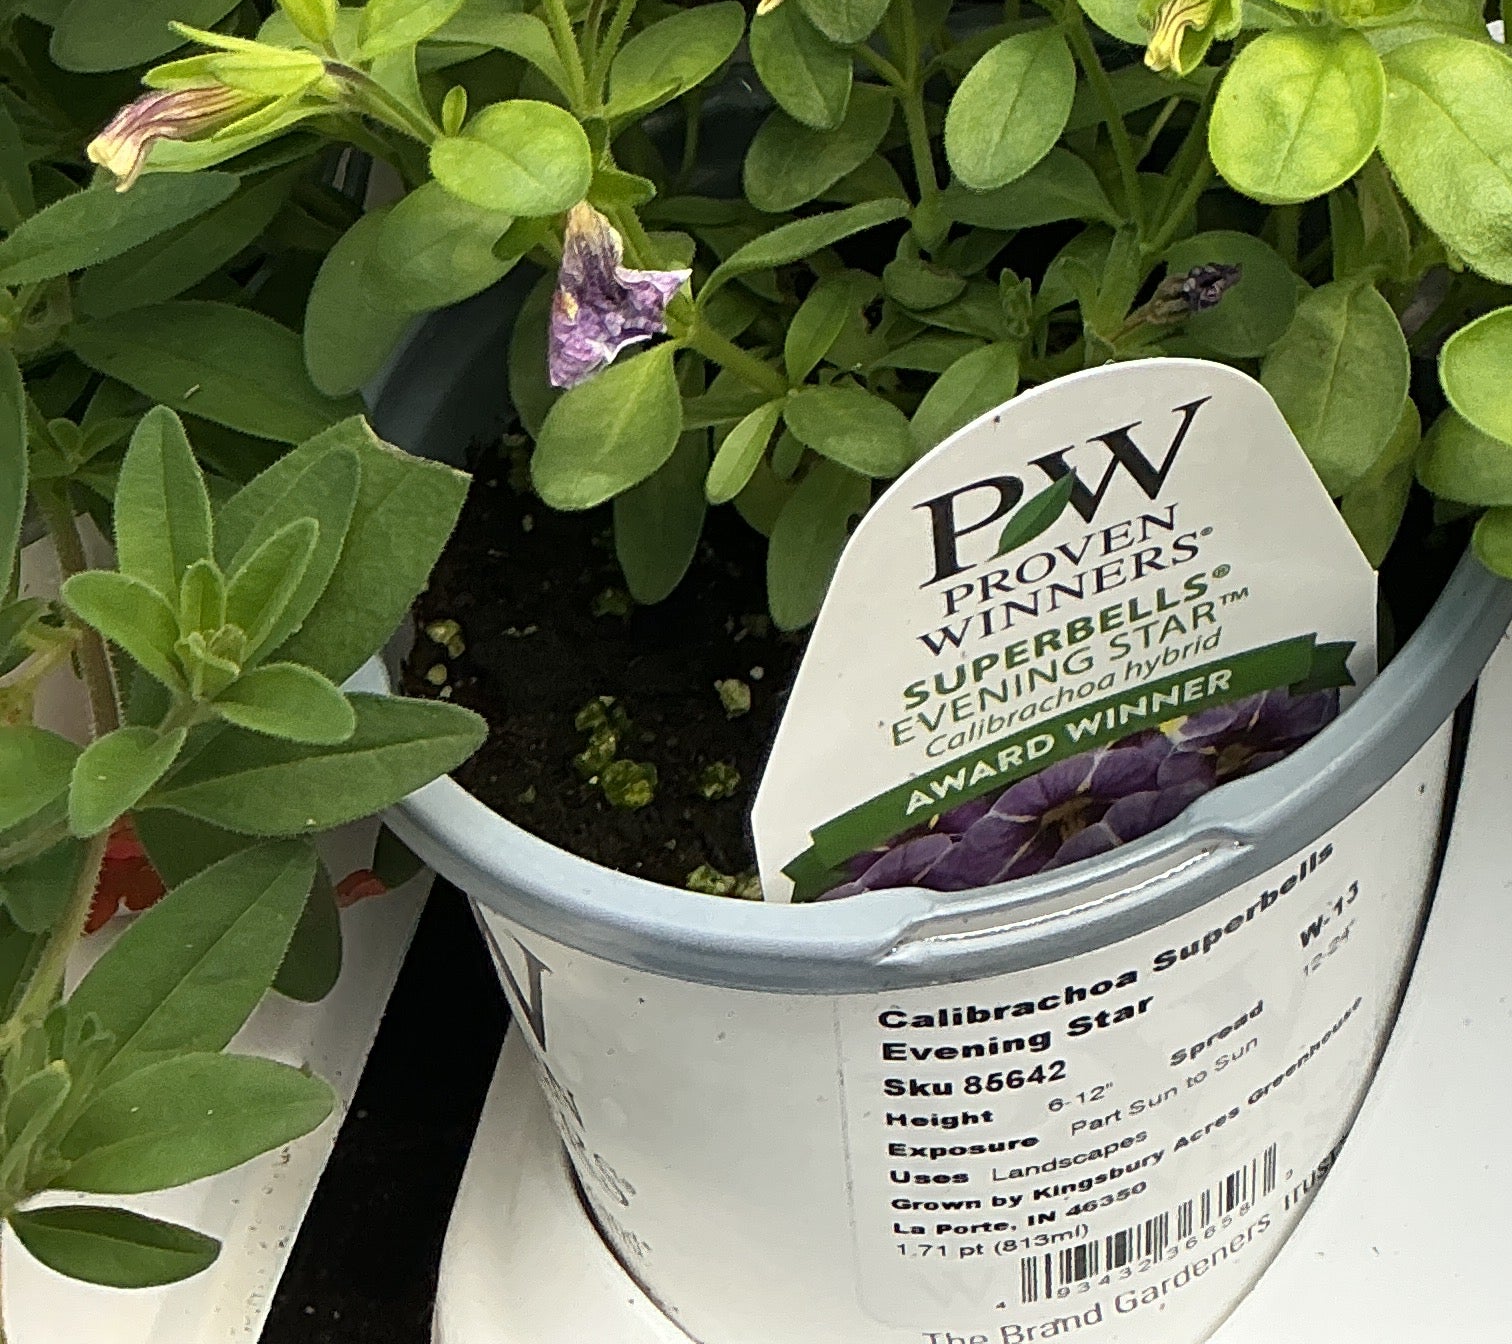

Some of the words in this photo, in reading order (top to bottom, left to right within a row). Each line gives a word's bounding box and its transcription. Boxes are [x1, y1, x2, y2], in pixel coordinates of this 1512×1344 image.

[912, 396, 1213, 590] PW
[942, 502, 1178, 618] PROVEN
[891, 646, 1094, 747] EVENING
[906, 733, 1055, 815] AWARD
[1065, 669, 1232, 742] WINNER
[926, 672, 1115, 757] Calibrachoa
[1125, 627, 1223, 681] hybrid
[879, 970, 1138, 1028] Calibrachoa
[1152, 843, 1333, 972] Superbells
[883, 1078, 953, 1096] Sku
[963, 1060, 1066, 1094] 85642
[1300, 880, 1359, 948] W-13
[882, 1031, 1051, 1061] Evening
[1066, 996, 1154, 1036] Star
[886, 1110, 994, 1129] Height
[1169, 1000, 1263, 1067] Spread
[888, 1136, 1040, 1160] Exposure
[1071, 1109, 1122, 1136] Part
[1128, 1087, 1178, 1116] Sun
[1186, 1071, 1208, 1088] to
[1214, 1037, 1258, 1072] Sun
[889, 1170, 969, 1184] Uses
[992, 1130, 1148, 1181] Landscapes
[890, 1198, 982, 1211] Grown
[991, 1194, 1023, 1208] by
[1033, 1149, 1165, 1201] Kingsbury
[1174, 1107, 1240, 1152] Acres
[1248, 997, 1362, 1105] Greenhouse
[893, 1223, 925, 1234] La
[1028, 1211, 1056, 1226] IN
[1065, 1180, 1147, 1216] 46350
[897, 1243, 947, 1257] 1.71
[960, 1243, 984, 1259] pt
[994, 1223, 1089, 1256] (813ml)
[922, 1332, 988, 1344] The
[1000, 1302, 1103, 1344] Brand
[1115, 1213, 1271, 1313] Gardeners
